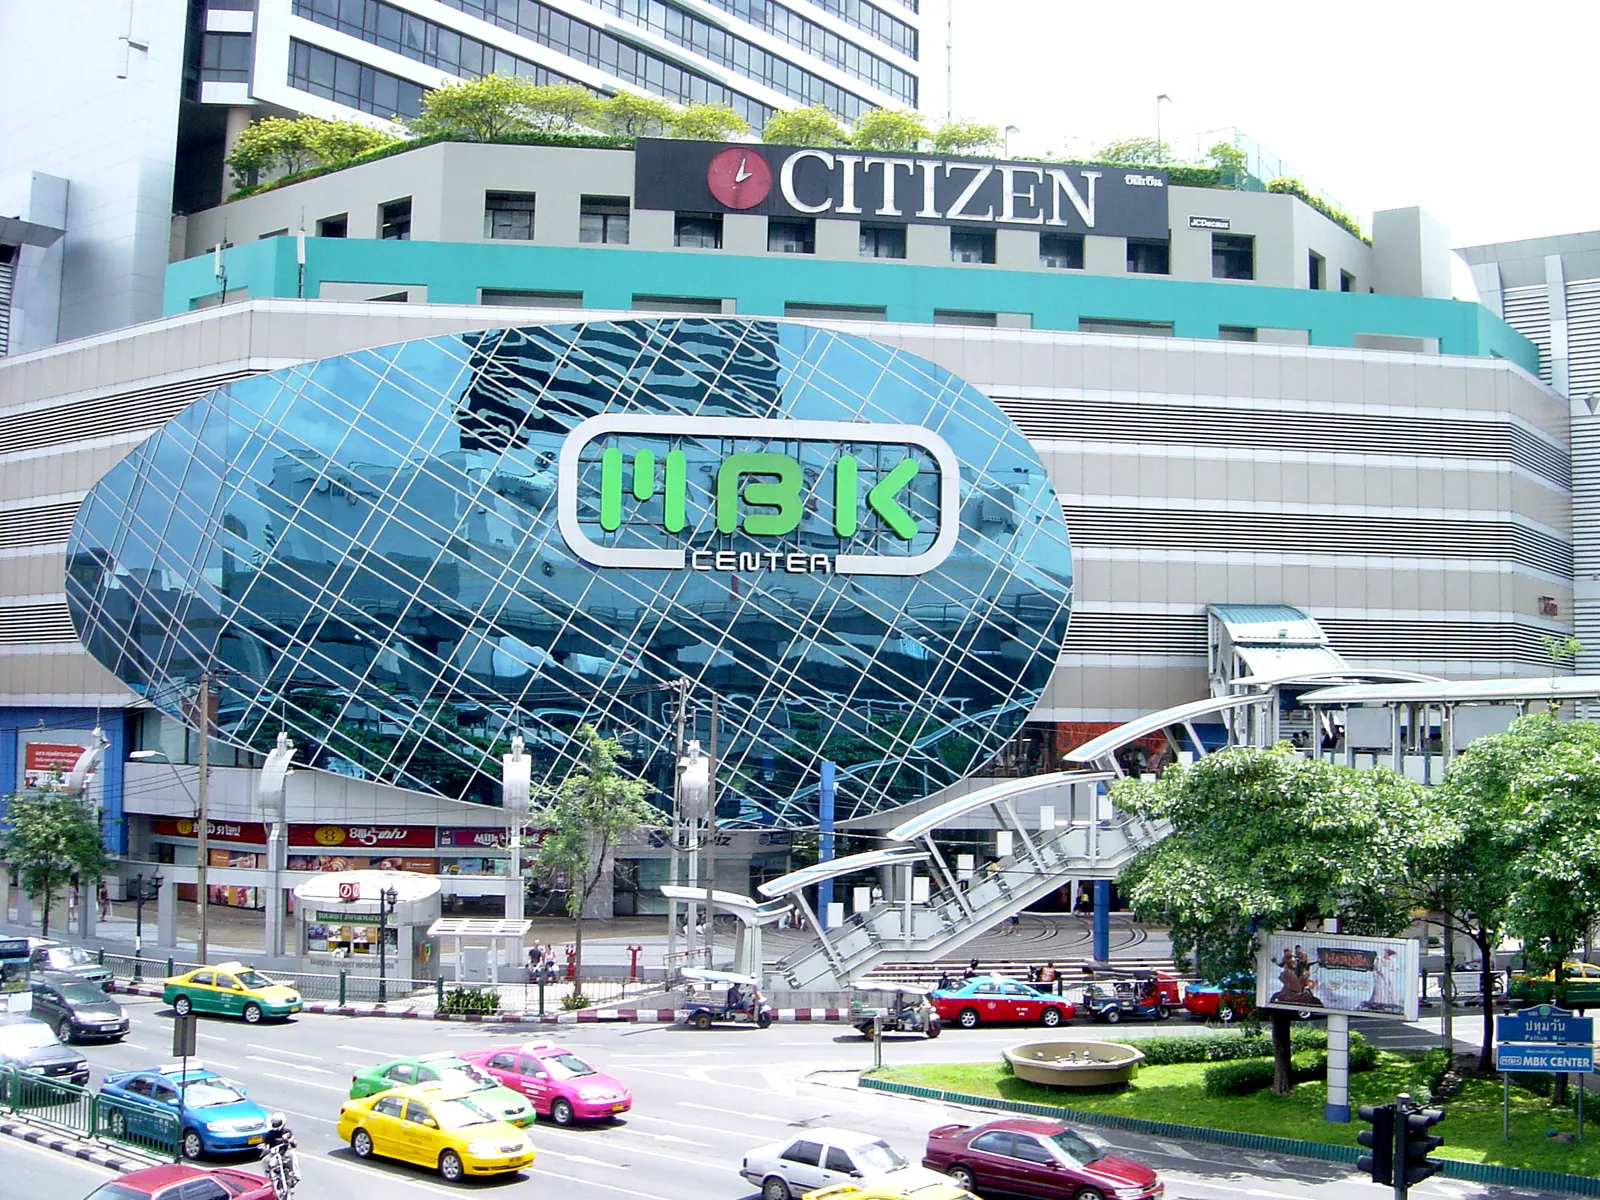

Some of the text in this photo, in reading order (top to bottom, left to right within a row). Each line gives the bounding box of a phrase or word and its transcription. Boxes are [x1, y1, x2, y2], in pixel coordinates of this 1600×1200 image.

[780, 149, 1102, 228] CITIZEN
[1190, 219, 1229, 228] JCDecaux
[600, 447, 919, 539] MBK
[692, 551, 832, 574] CENTER
[1525, 1018, 1565, 1034] ปทุมวัน
[1523, 1056, 1548, 1067] MBK
[1550, 1057, 1590, 1068] CENTER
